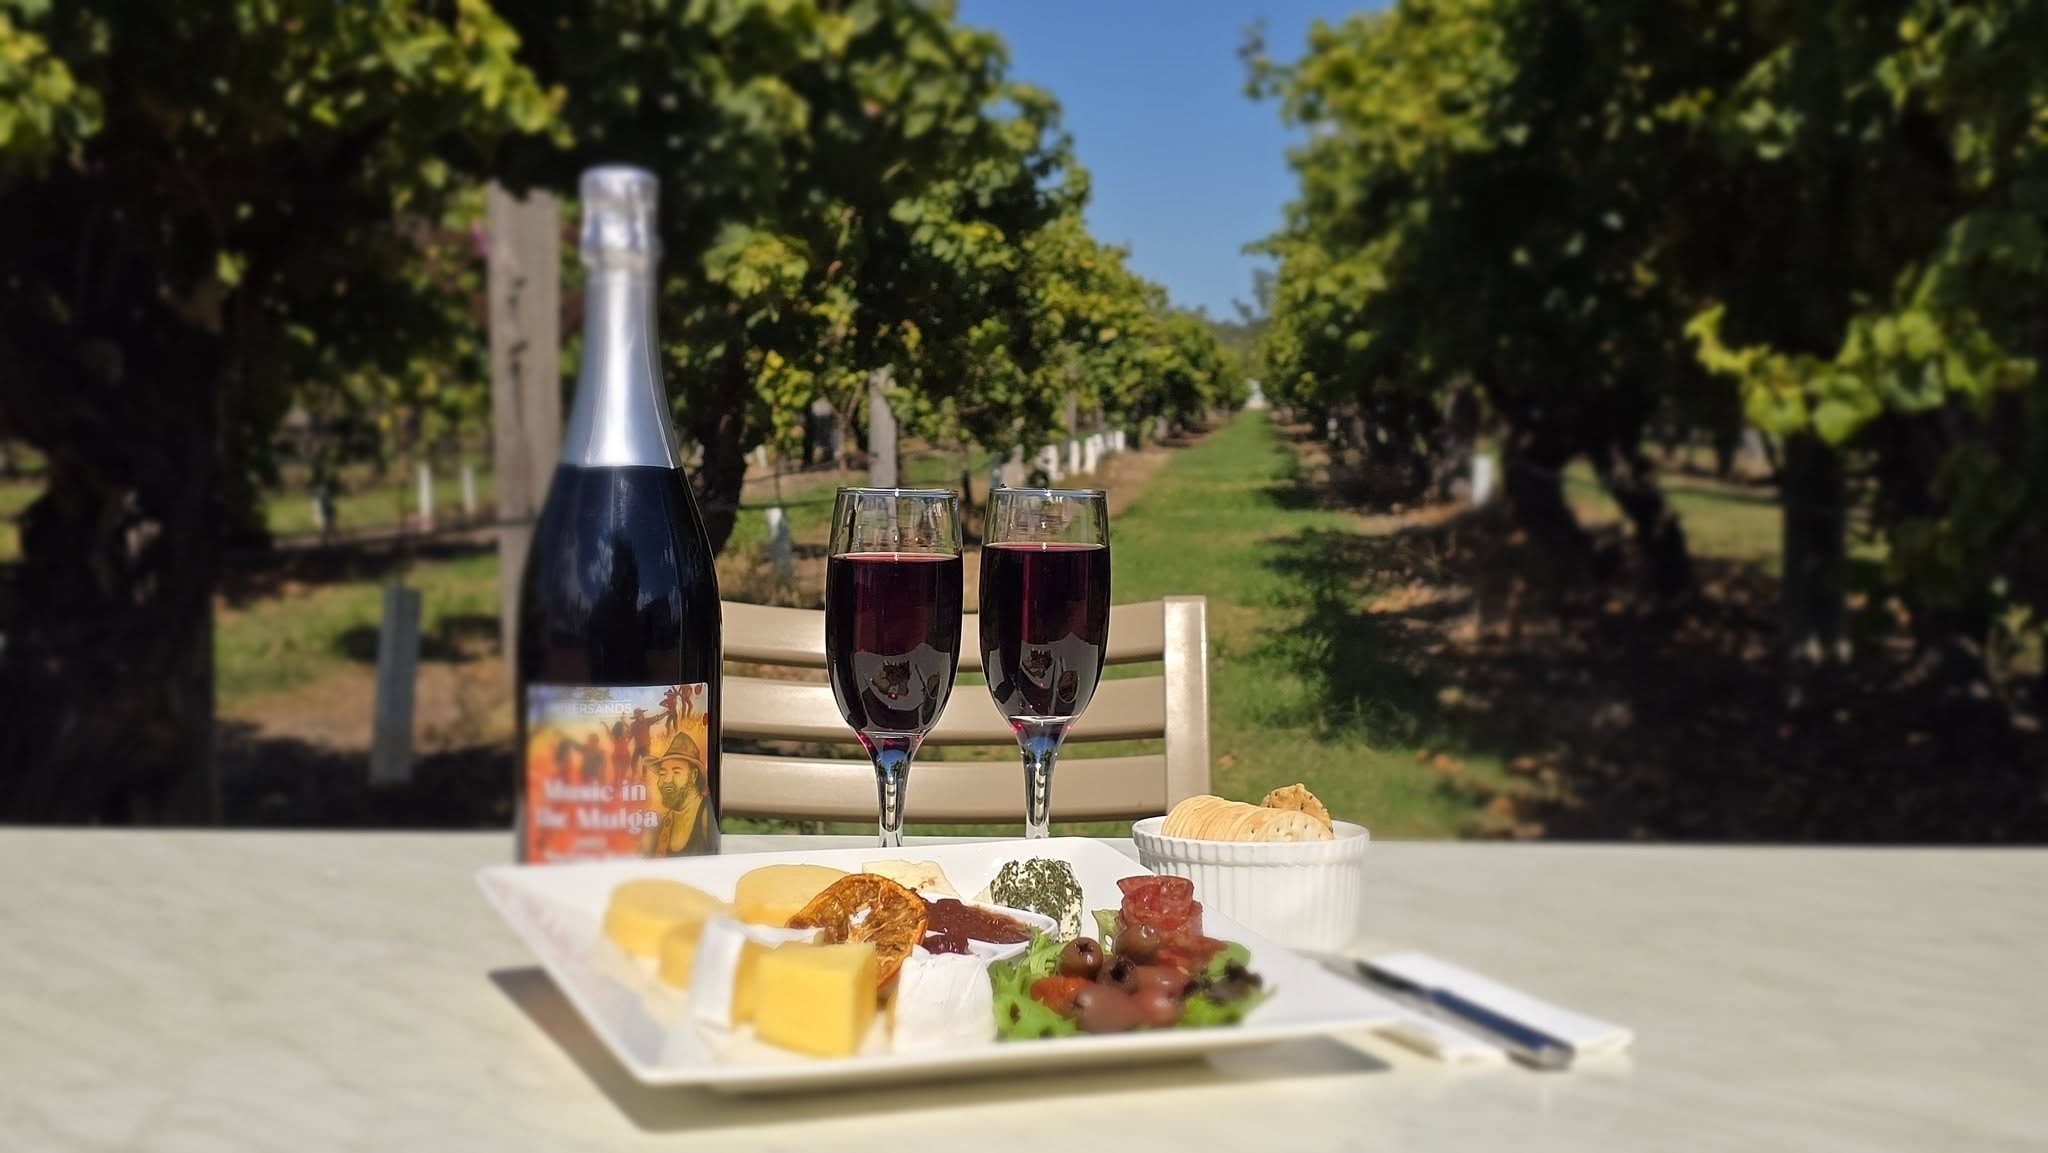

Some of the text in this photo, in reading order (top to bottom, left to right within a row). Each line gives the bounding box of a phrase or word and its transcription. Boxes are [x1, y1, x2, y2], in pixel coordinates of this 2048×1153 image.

[542, 779, 648, 802] Music in
[577, 806, 660, 834] Mulga
